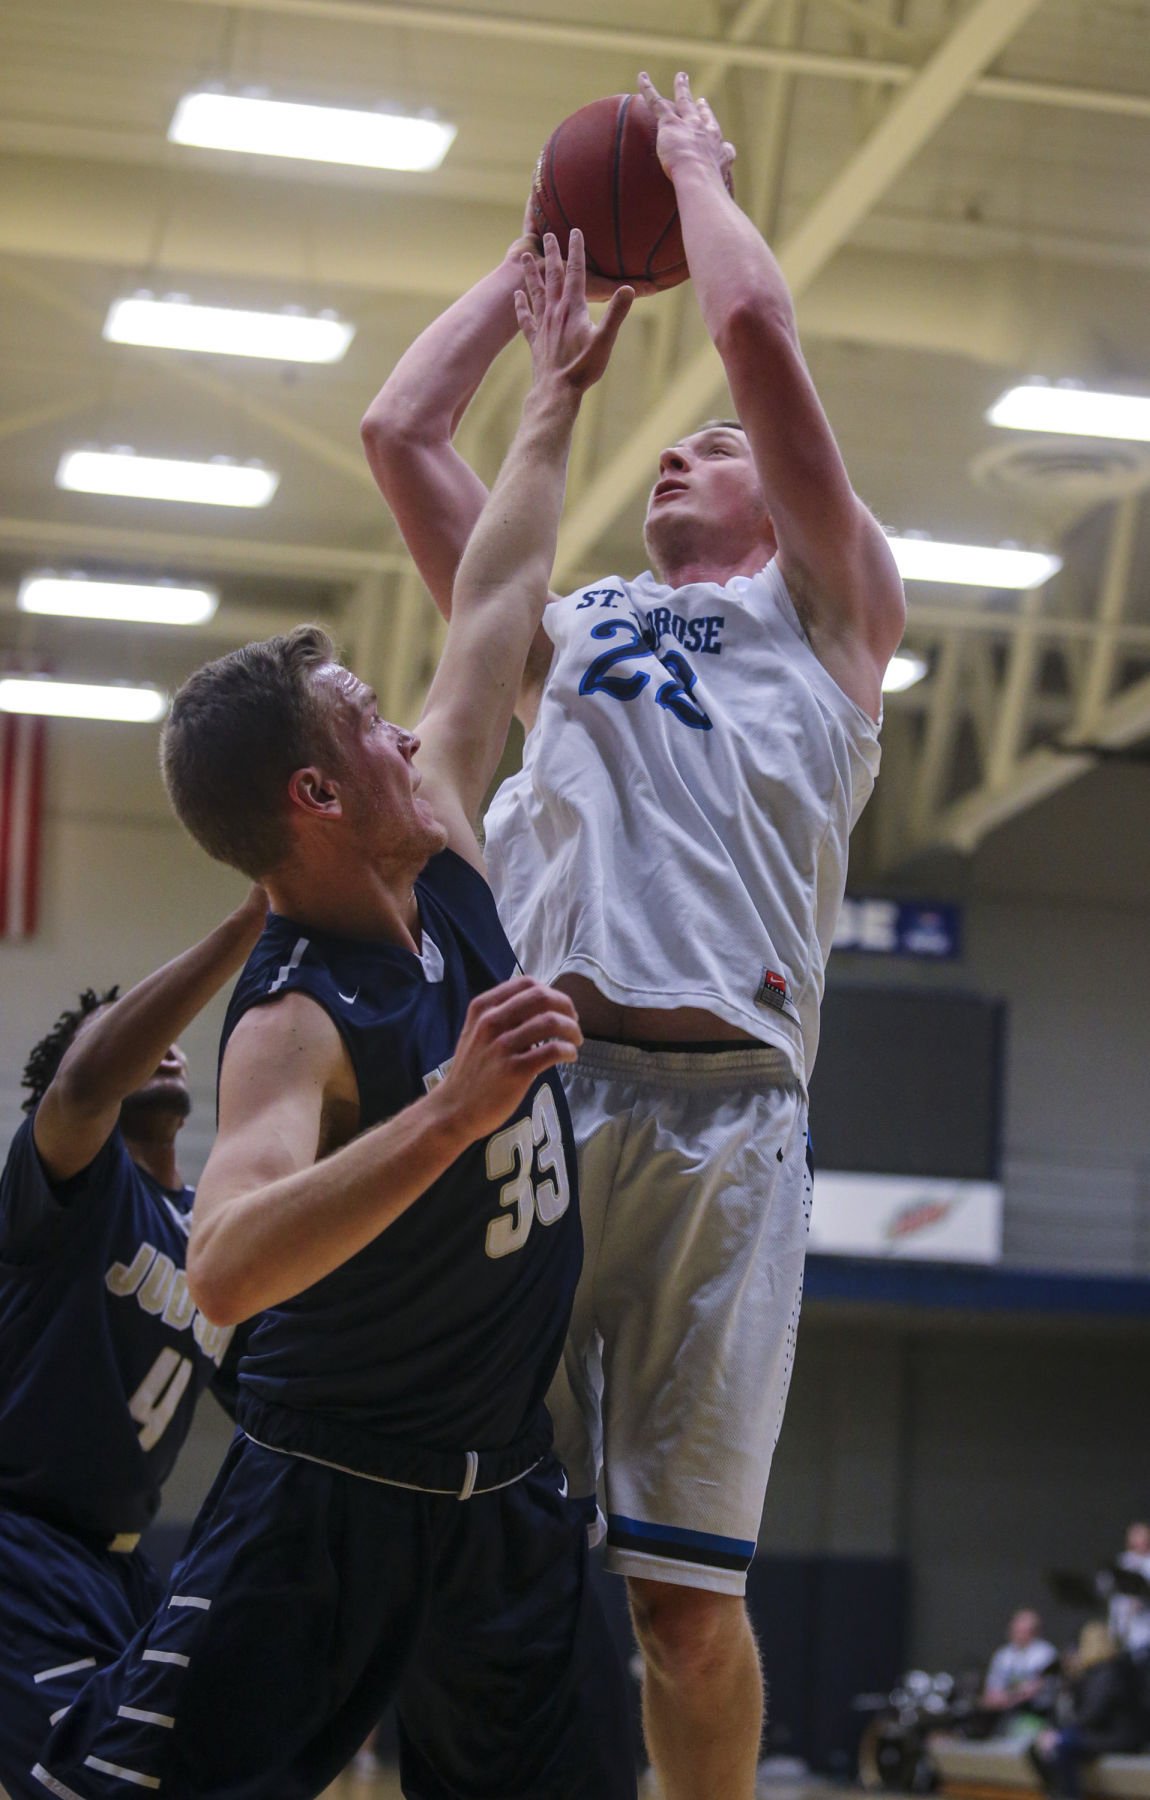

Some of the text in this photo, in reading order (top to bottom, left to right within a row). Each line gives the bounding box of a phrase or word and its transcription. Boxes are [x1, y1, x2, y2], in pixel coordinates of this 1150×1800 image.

[575, 588, 624, 611] ST.
[485, 1083, 570, 1259] 33
[128, 1346, 193, 1452] 4
